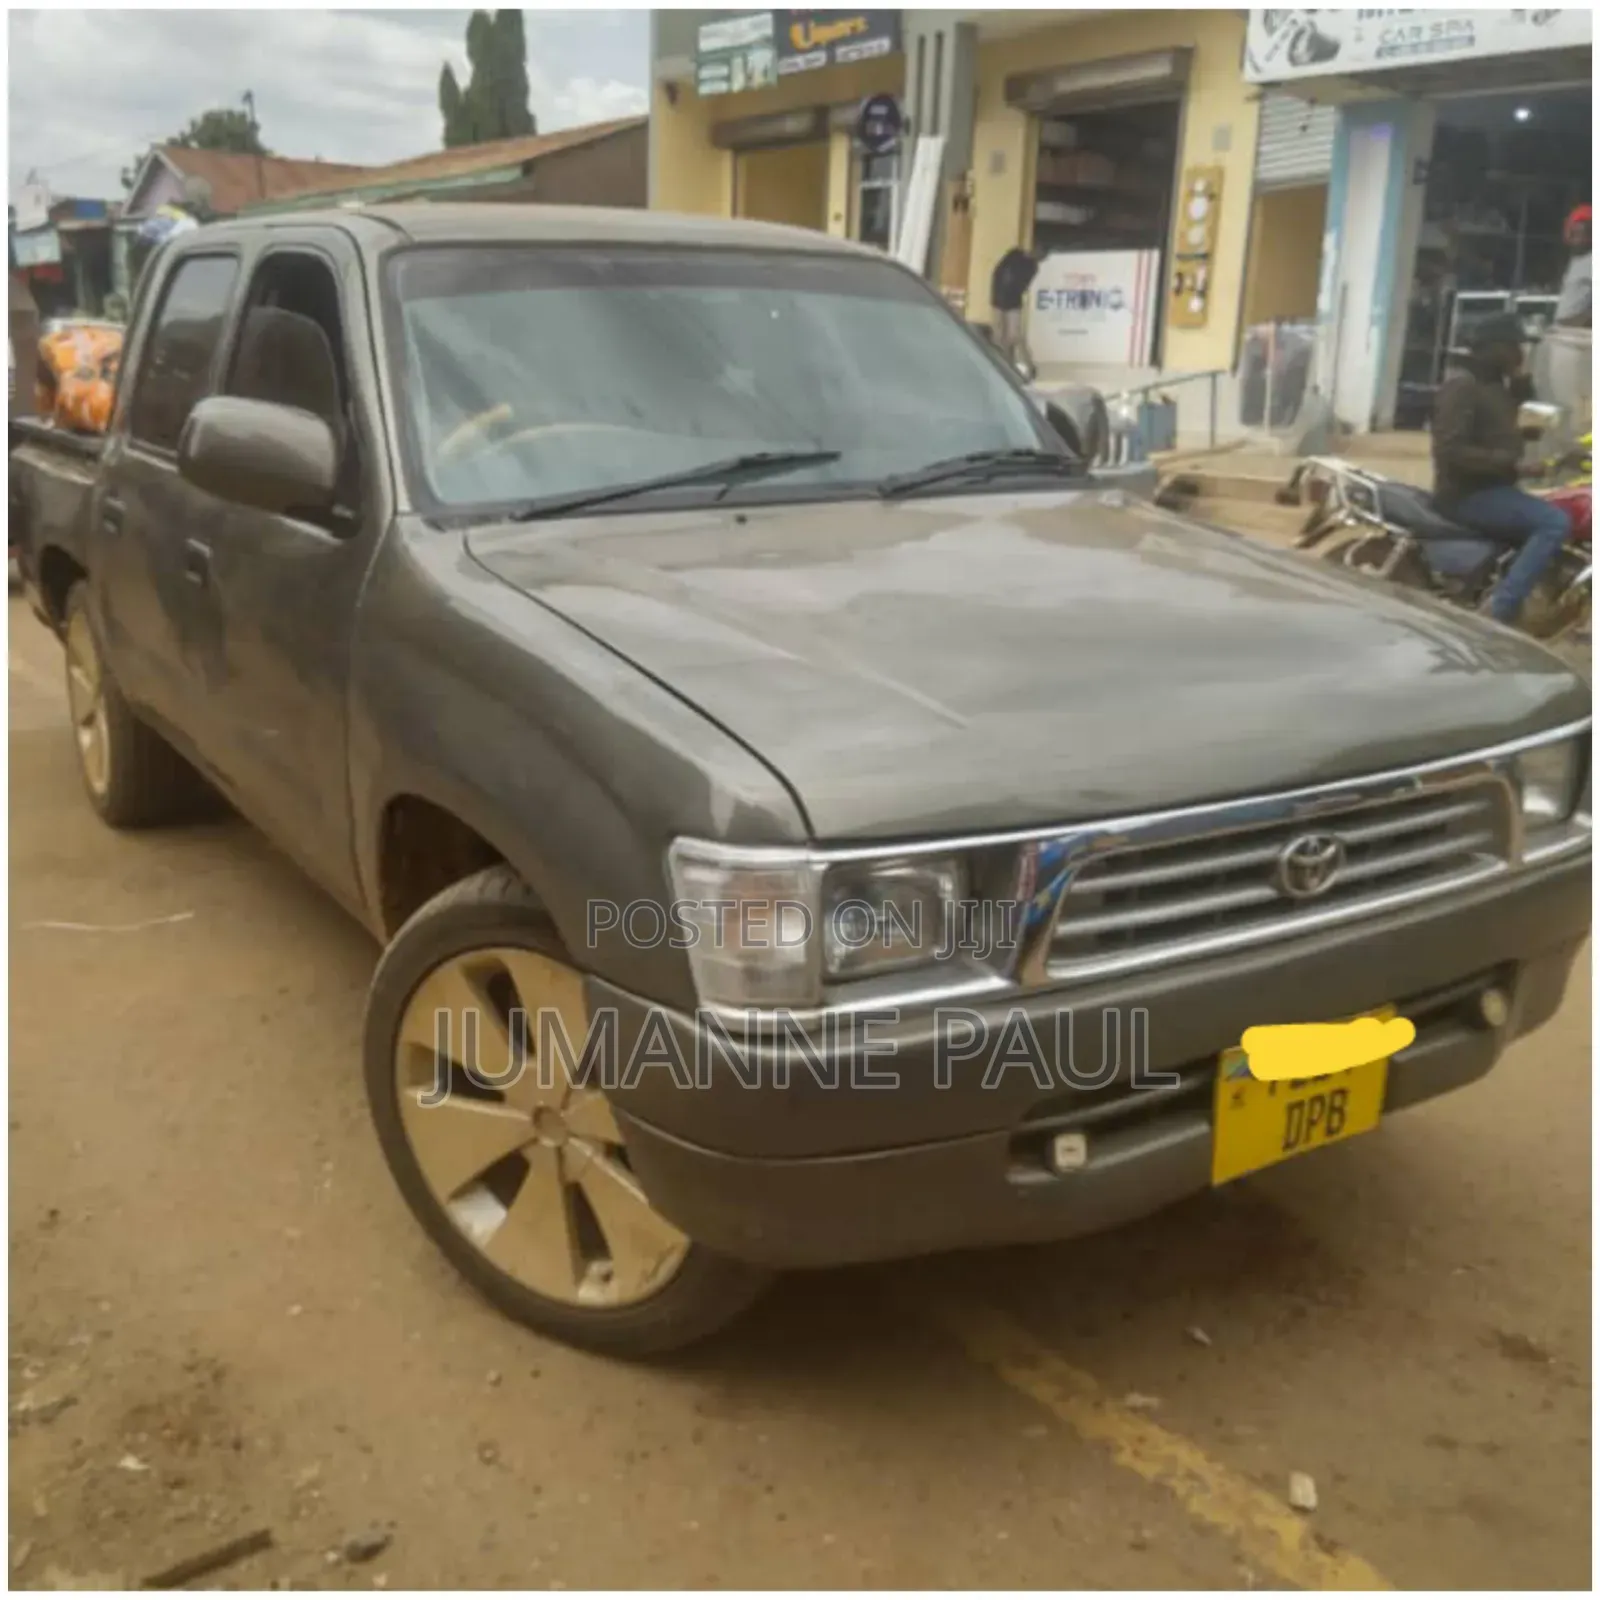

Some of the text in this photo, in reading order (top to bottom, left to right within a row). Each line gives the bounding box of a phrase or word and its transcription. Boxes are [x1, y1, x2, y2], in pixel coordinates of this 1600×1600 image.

[1379, 19, 1476, 46] CAR SPA
[1281, 1087, 1349, 1152] DPB
